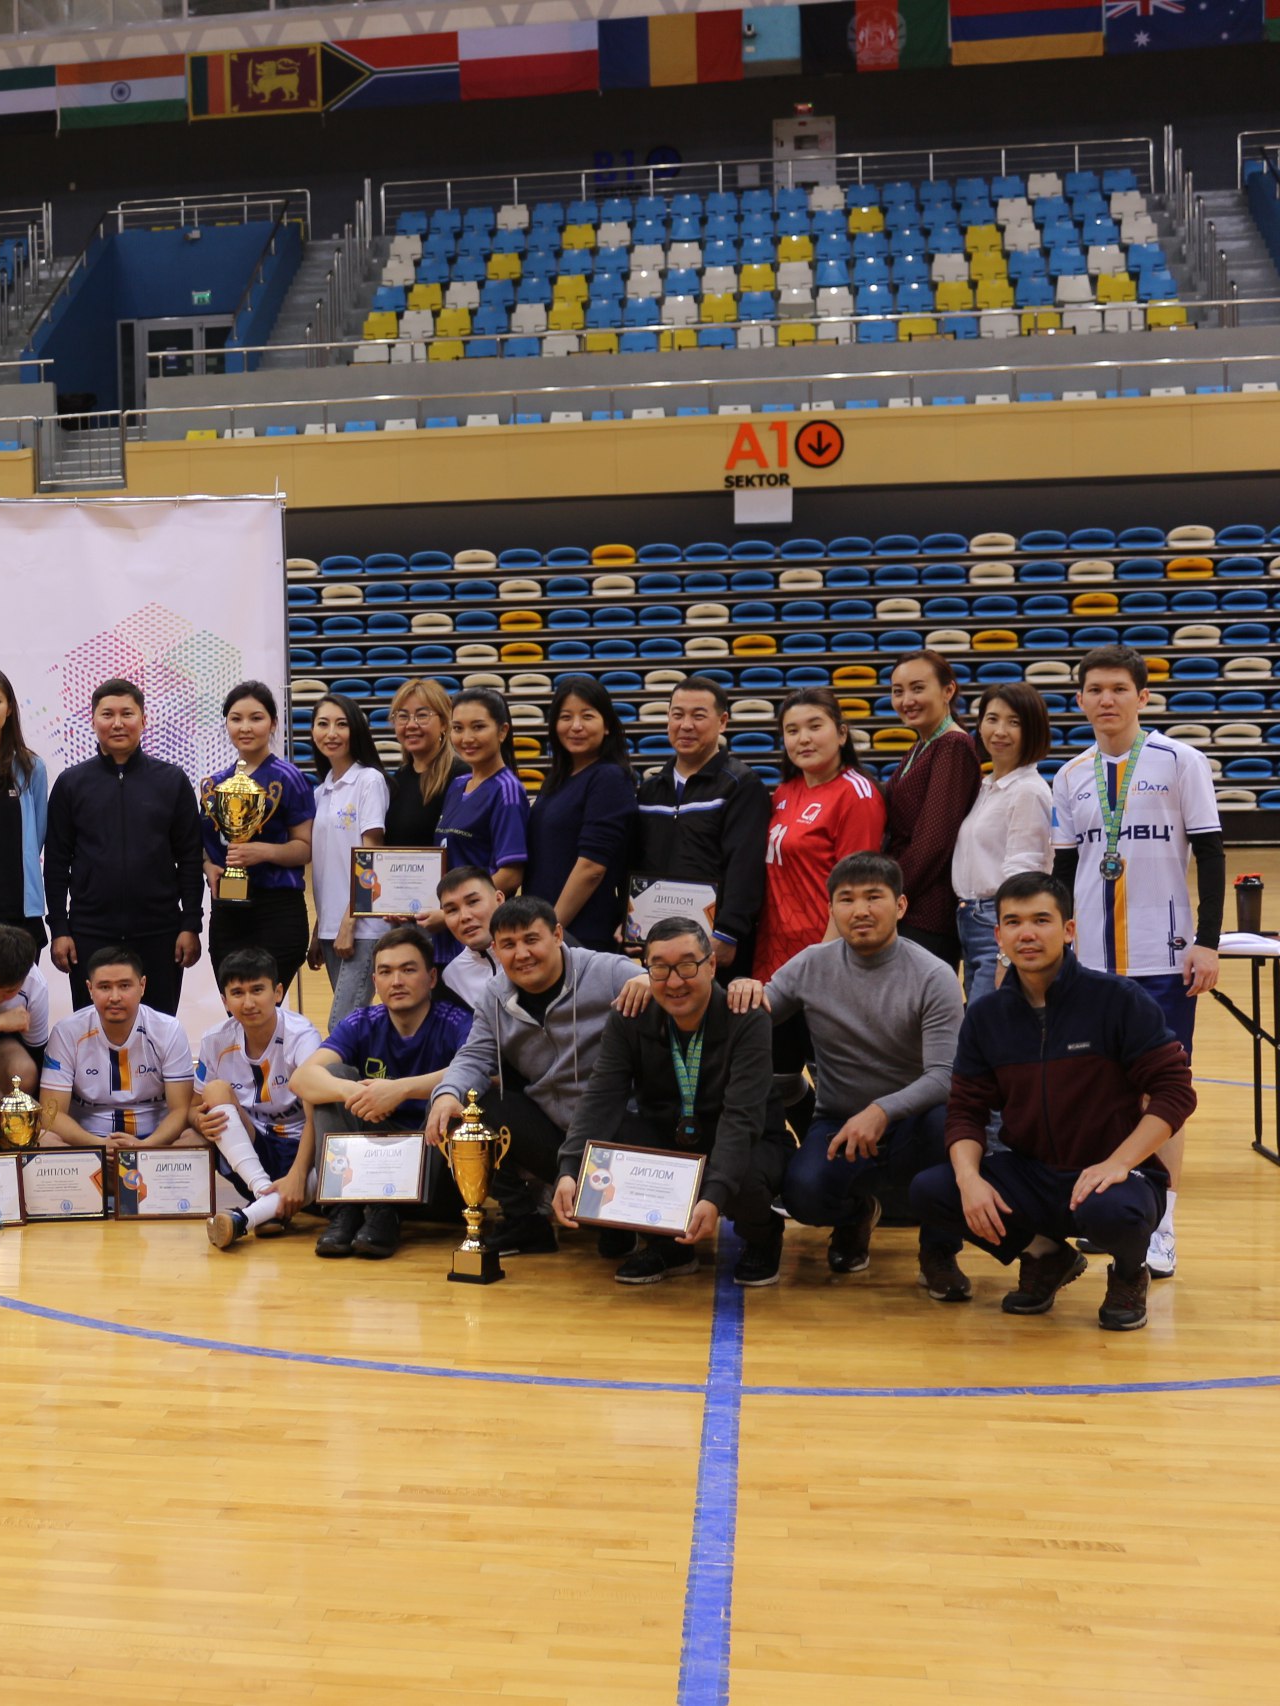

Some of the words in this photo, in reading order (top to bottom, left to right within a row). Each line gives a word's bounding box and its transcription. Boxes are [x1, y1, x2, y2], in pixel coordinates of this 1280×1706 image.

[724, 421, 788, 470] A1
[724, 473, 791, 488] SEKTOR
[765, 823, 788, 866] 11
[389, 863, 425, 873] ДИПЛОМ
[653, 894, 694, 907] ДИПЛОМ
[363, 1149, 402, 1159] ДИПЛОМ
[36, 1166, 79, 1178] ДИПЛОМ
[155, 1161, 192, 1172] ДИПЛОМ
[630, 1166, 674, 1181] ДИПЛОМ
